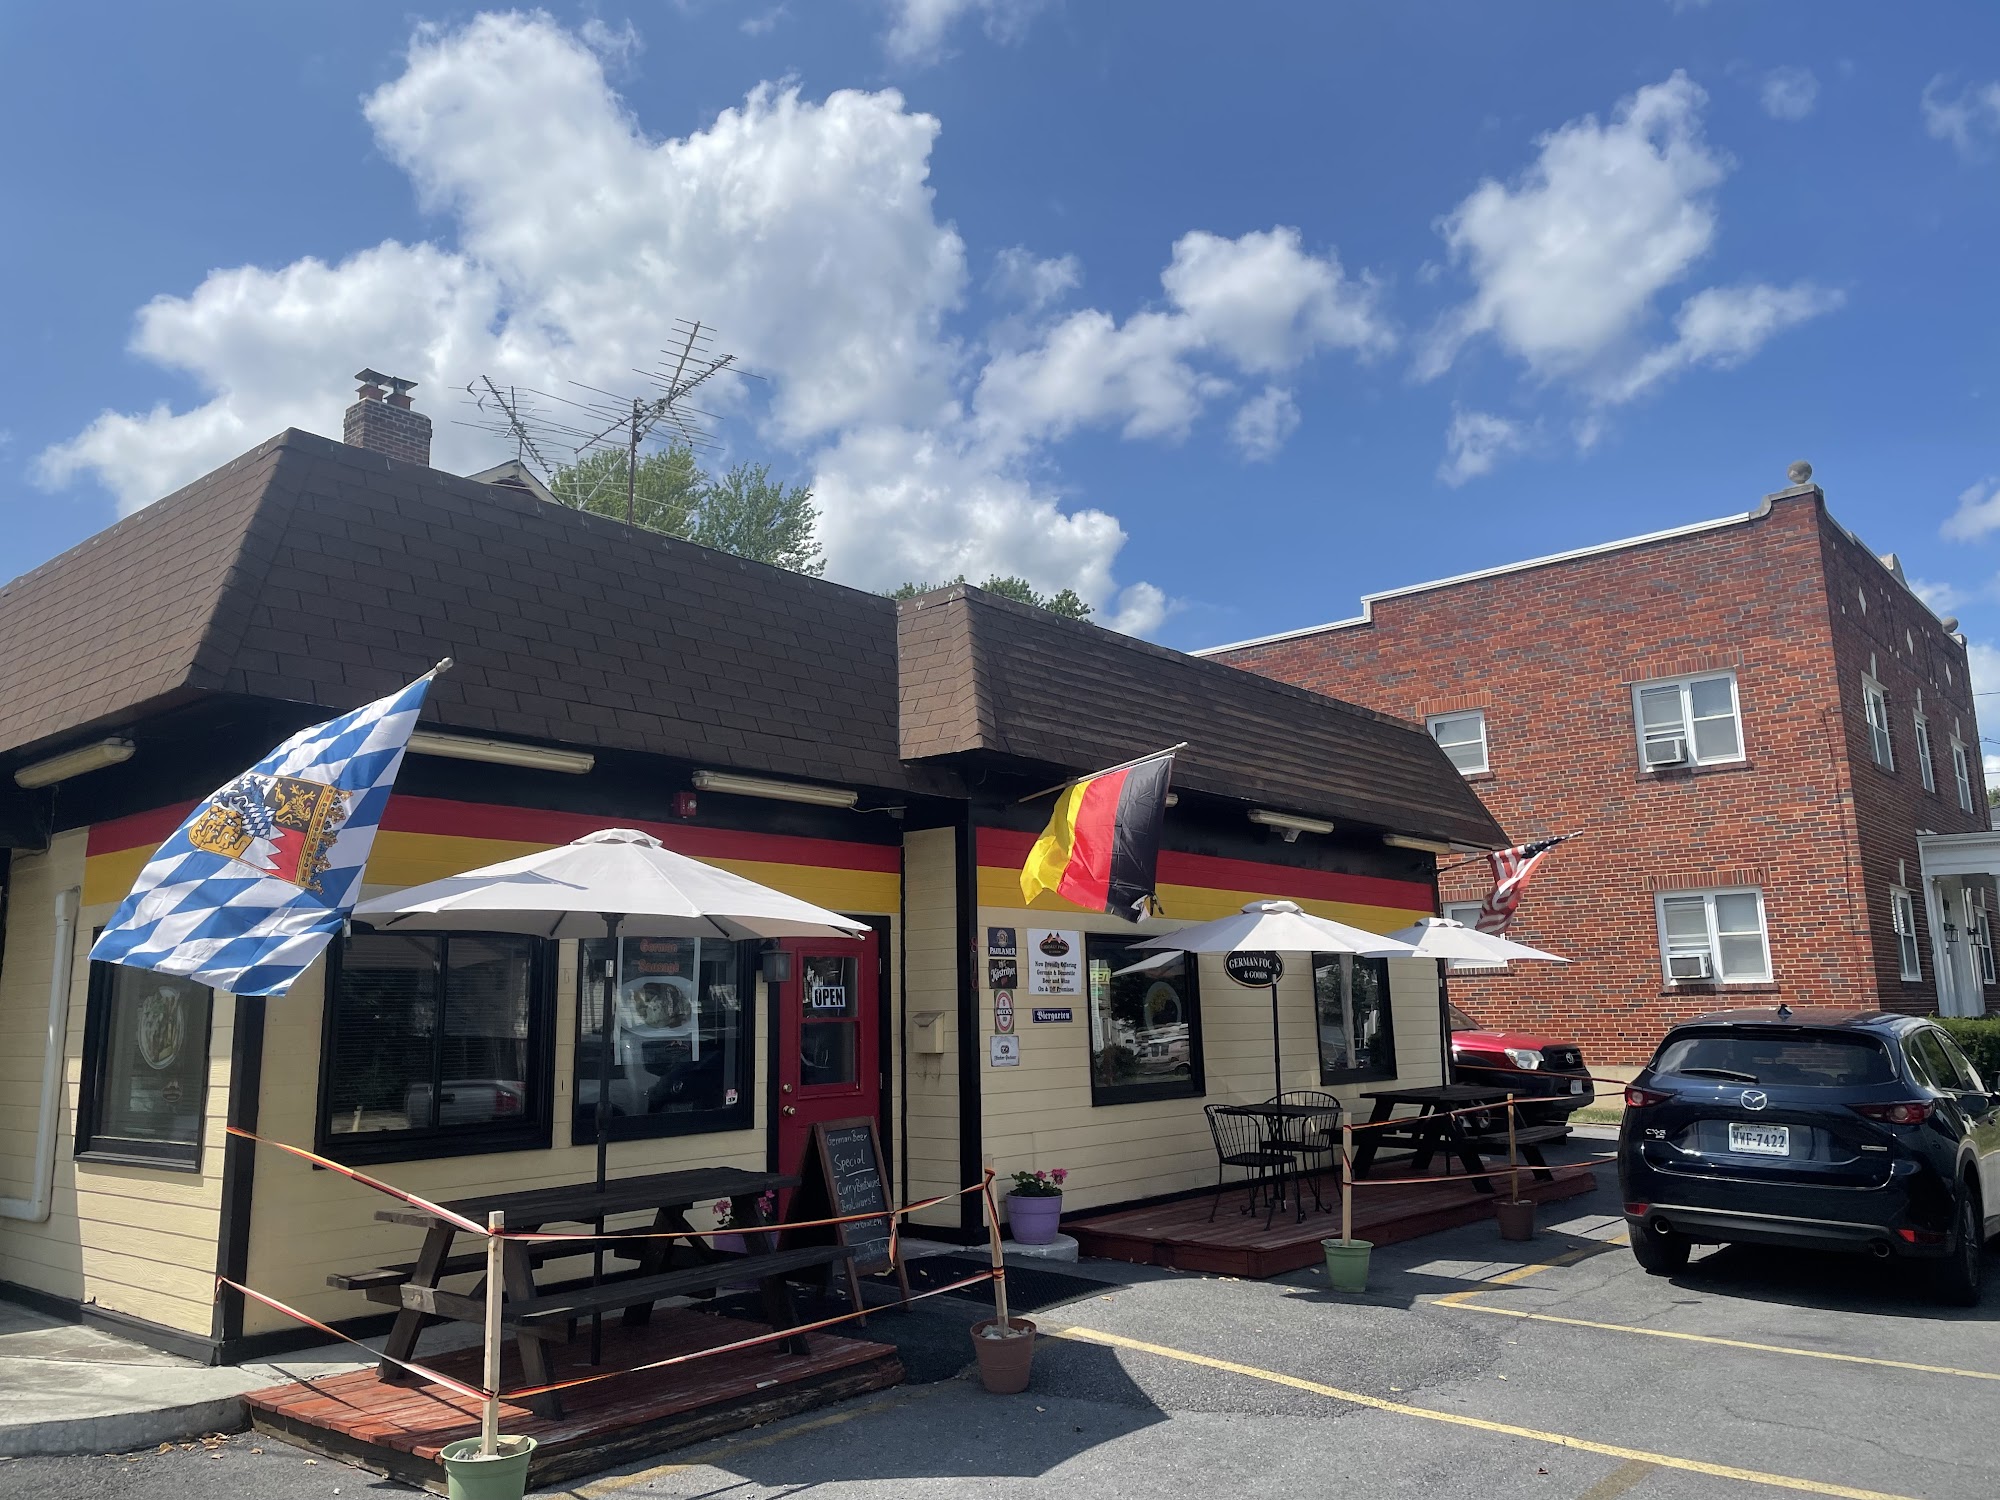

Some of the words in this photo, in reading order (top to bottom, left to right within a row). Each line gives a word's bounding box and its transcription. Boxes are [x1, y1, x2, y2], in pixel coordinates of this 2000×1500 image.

[640, 939, 678, 953] German
[989, 947, 1015, 955] PAULANER
[638, 959, 681, 975] Sausage
[1229, 957, 1258, 969] GERMAN
[1259, 958, 1280, 972] FOOS
[1249, 971, 1268, 979] GOODS
[815, 988, 843, 1006] OPEN
[1037, 1011, 1070, 1022] Biergarten
[834, 1149, 865, 1172] Special
